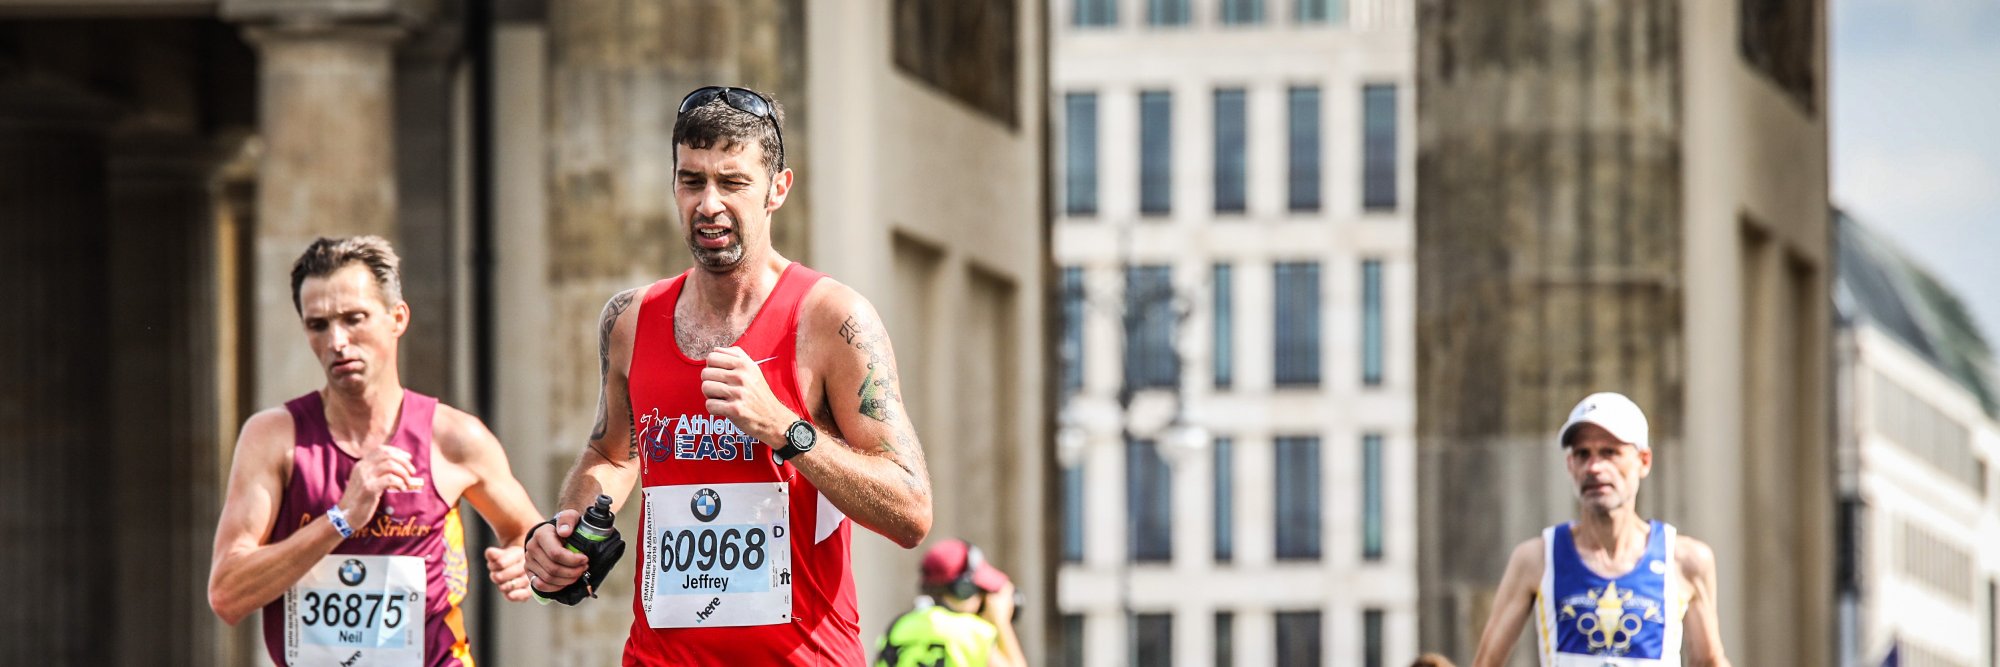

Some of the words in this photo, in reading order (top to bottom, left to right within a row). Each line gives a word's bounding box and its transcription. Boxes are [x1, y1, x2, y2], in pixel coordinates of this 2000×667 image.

[675, 434, 760, 461] EAST
[676, 434, 684, 459] North
[371, 516, 432, 537] Striders
[773, 525, 784, 538] D
[661, 527, 766, 573] 60968
[682, 573, 729, 592] Jeffrey
[301, 591, 405, 629] 36875
[696, 597, 721, 620] here
[338, 630, 363, 643] Neil
